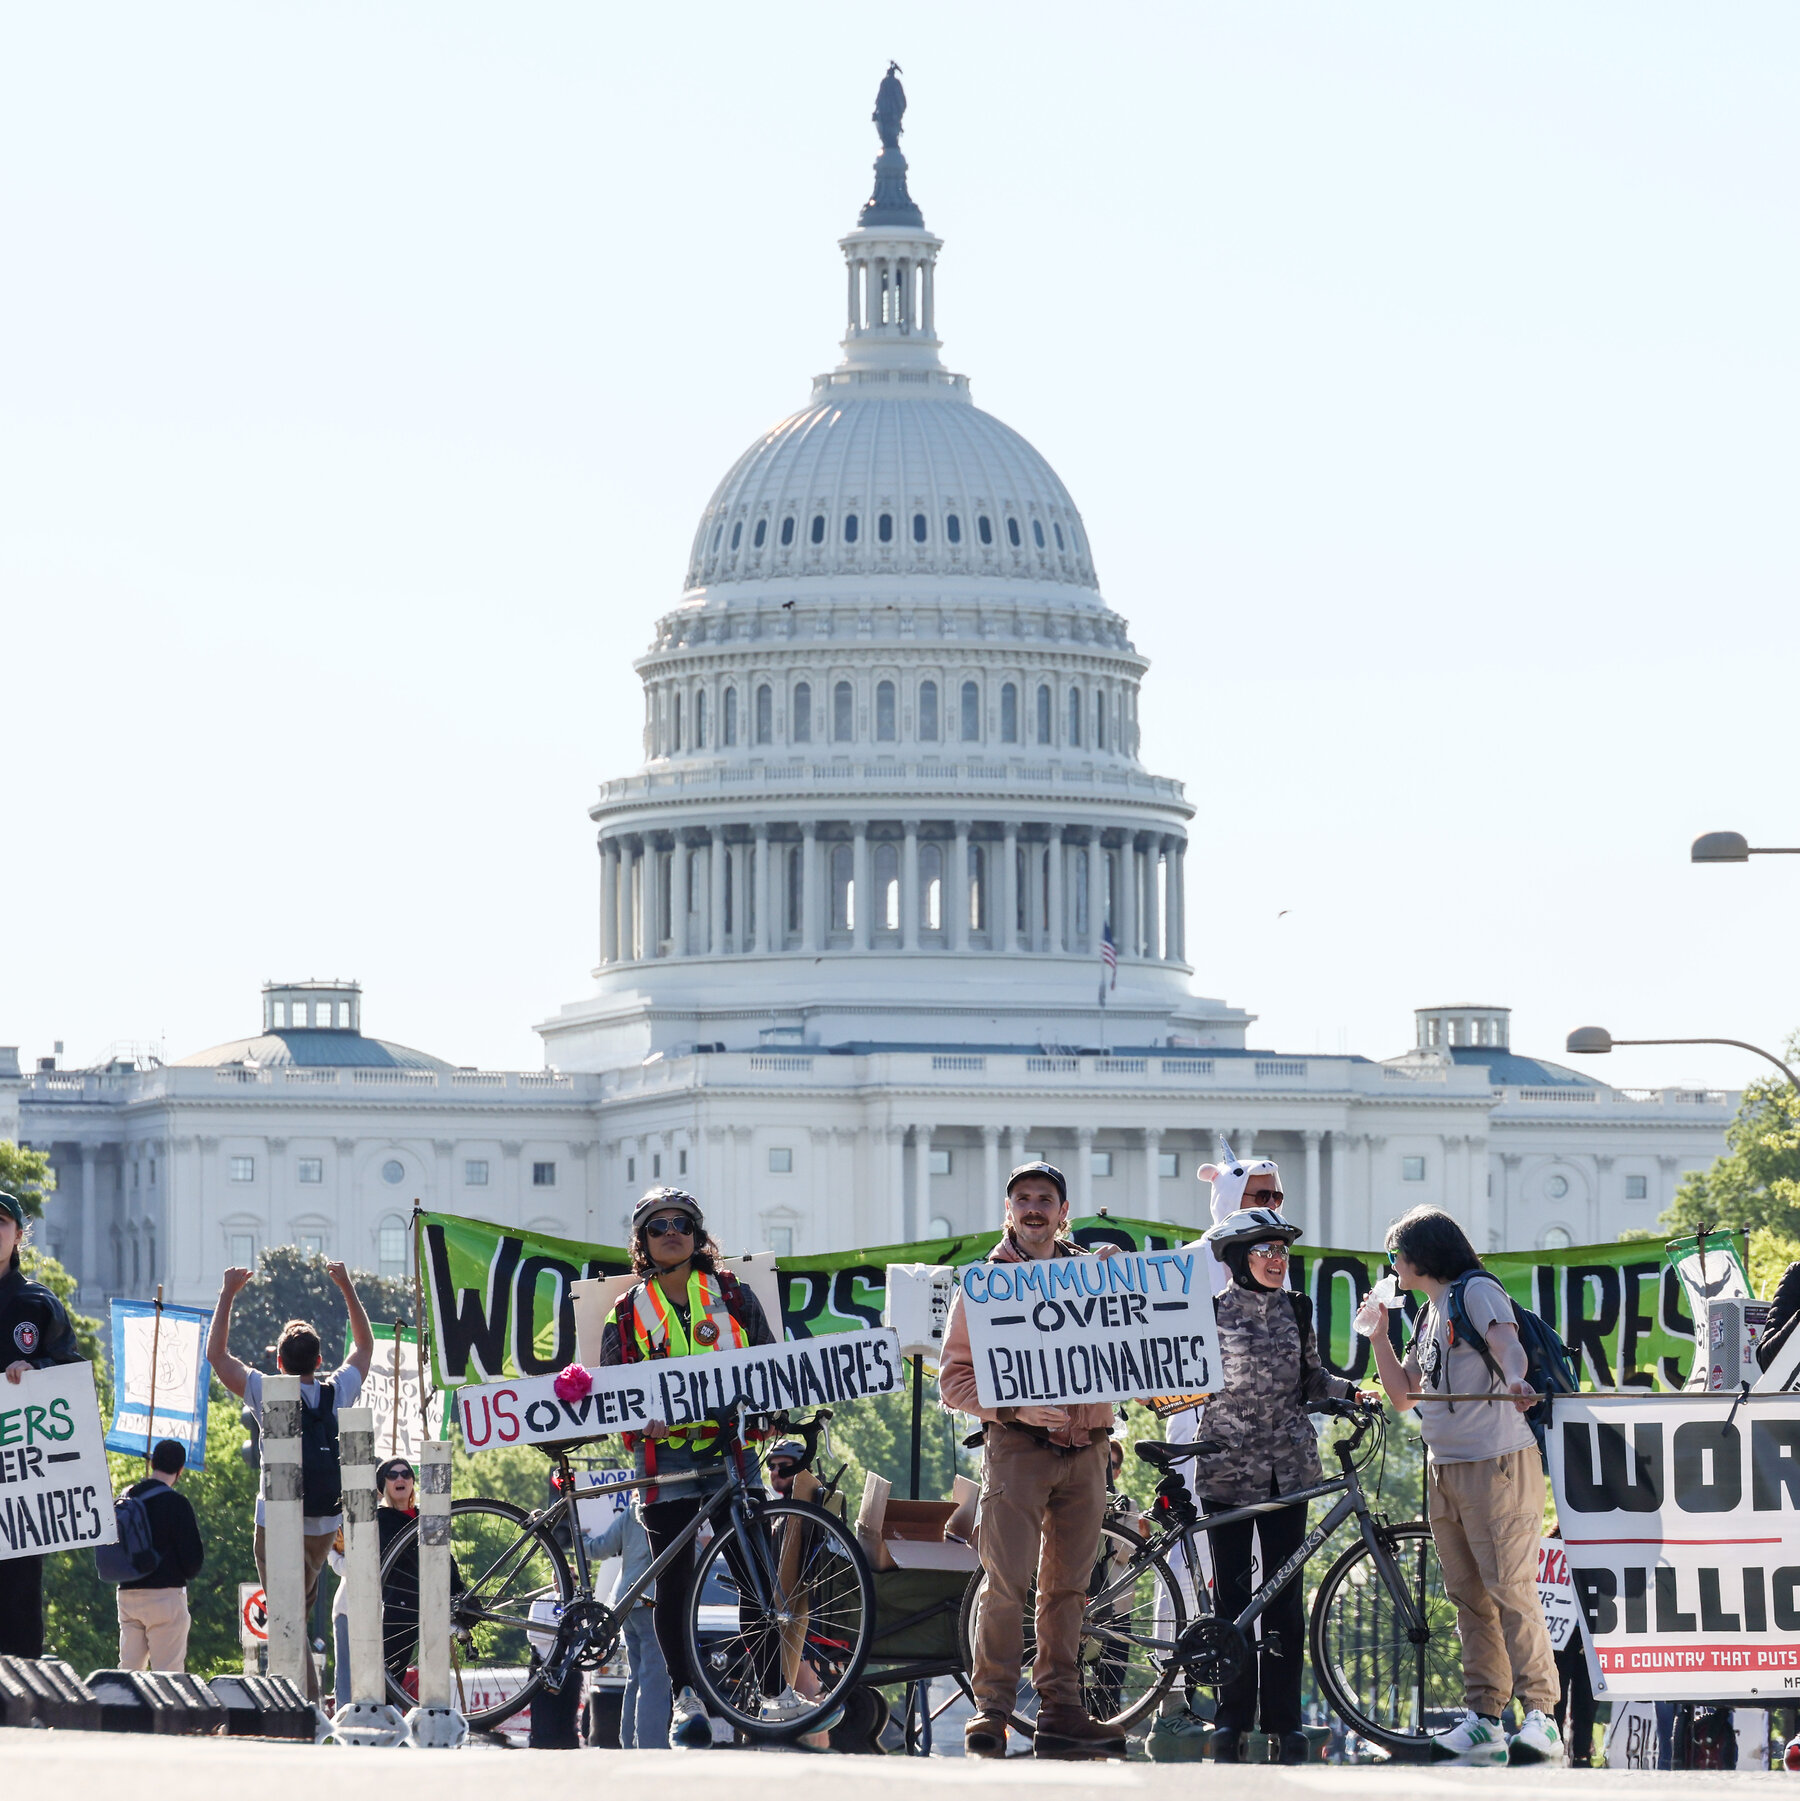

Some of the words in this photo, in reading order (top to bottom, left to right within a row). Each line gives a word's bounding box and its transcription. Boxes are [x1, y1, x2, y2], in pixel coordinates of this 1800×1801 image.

[422, 1224, 886, 1385] WORS
[964, 1254, 1194, 1303] COMMUNITY
[1032, 1293, 1150, 1332] OVER
[463, 1389, 520, 1447] US
[524, 1388, 647, 1433] OVER
[658, 1338, 894, 1427] BILLIONAIRES
[987, 1335, 1210, 1401] BILLIONAIRES
[1257, 1529, 1322, 1603] TREK
[1614, 1653, 1625, 1669] A
[1631, 1651, 1705, 1668] COUNTRY
[1710, 1650, 1752, 1667] THAT
[1757, 1650, 1798, 1666] PUTS
